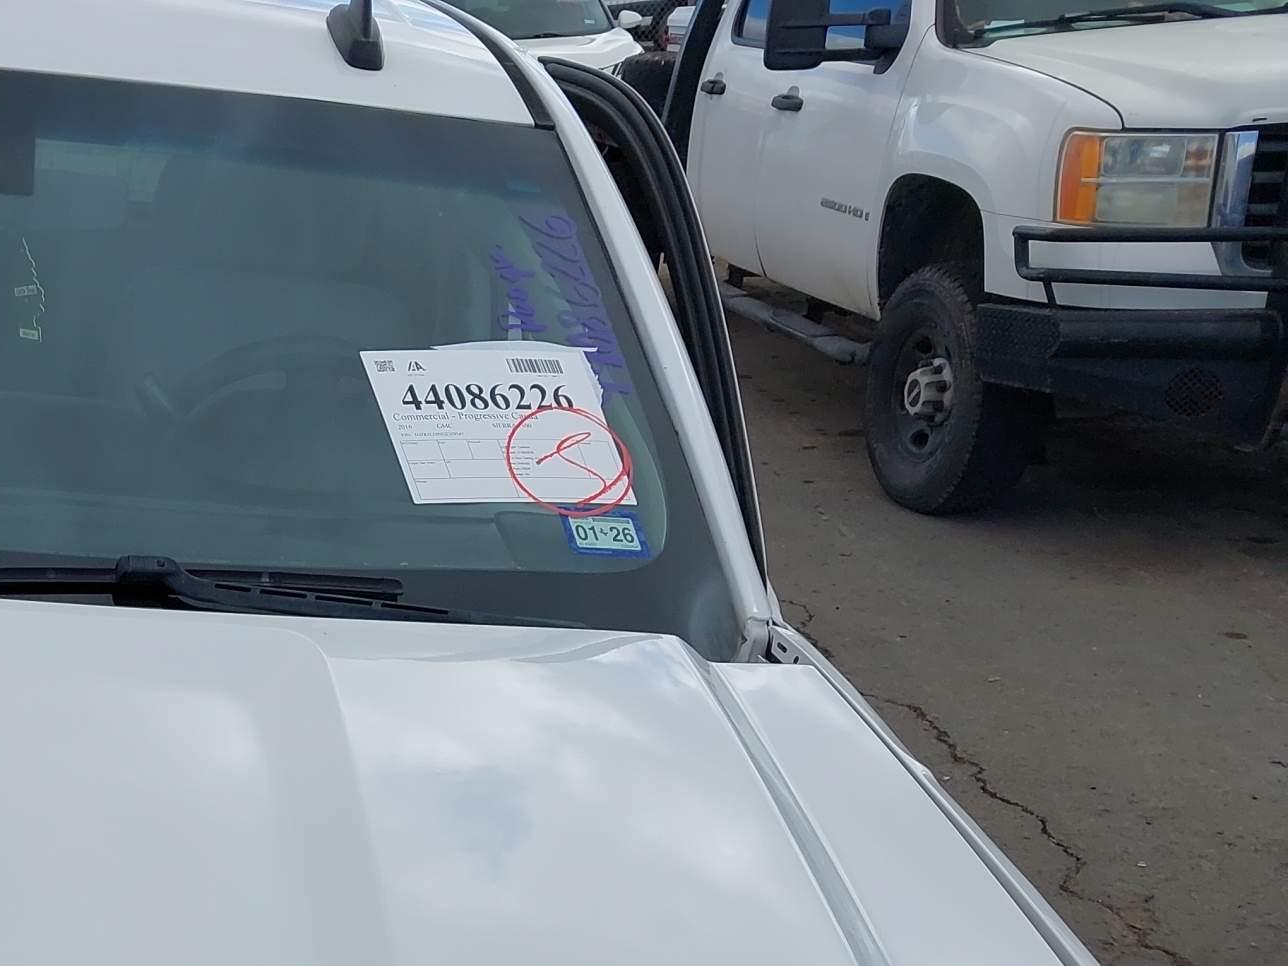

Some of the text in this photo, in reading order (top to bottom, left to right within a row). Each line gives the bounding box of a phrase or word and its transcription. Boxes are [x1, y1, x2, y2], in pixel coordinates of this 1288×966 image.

[401, 383, 574, 411] 44086226
[392, 411, 450, 421] Commercial
[458, 411, 510, 421] Progressive
[575, 524, 635, 544] 01 26
